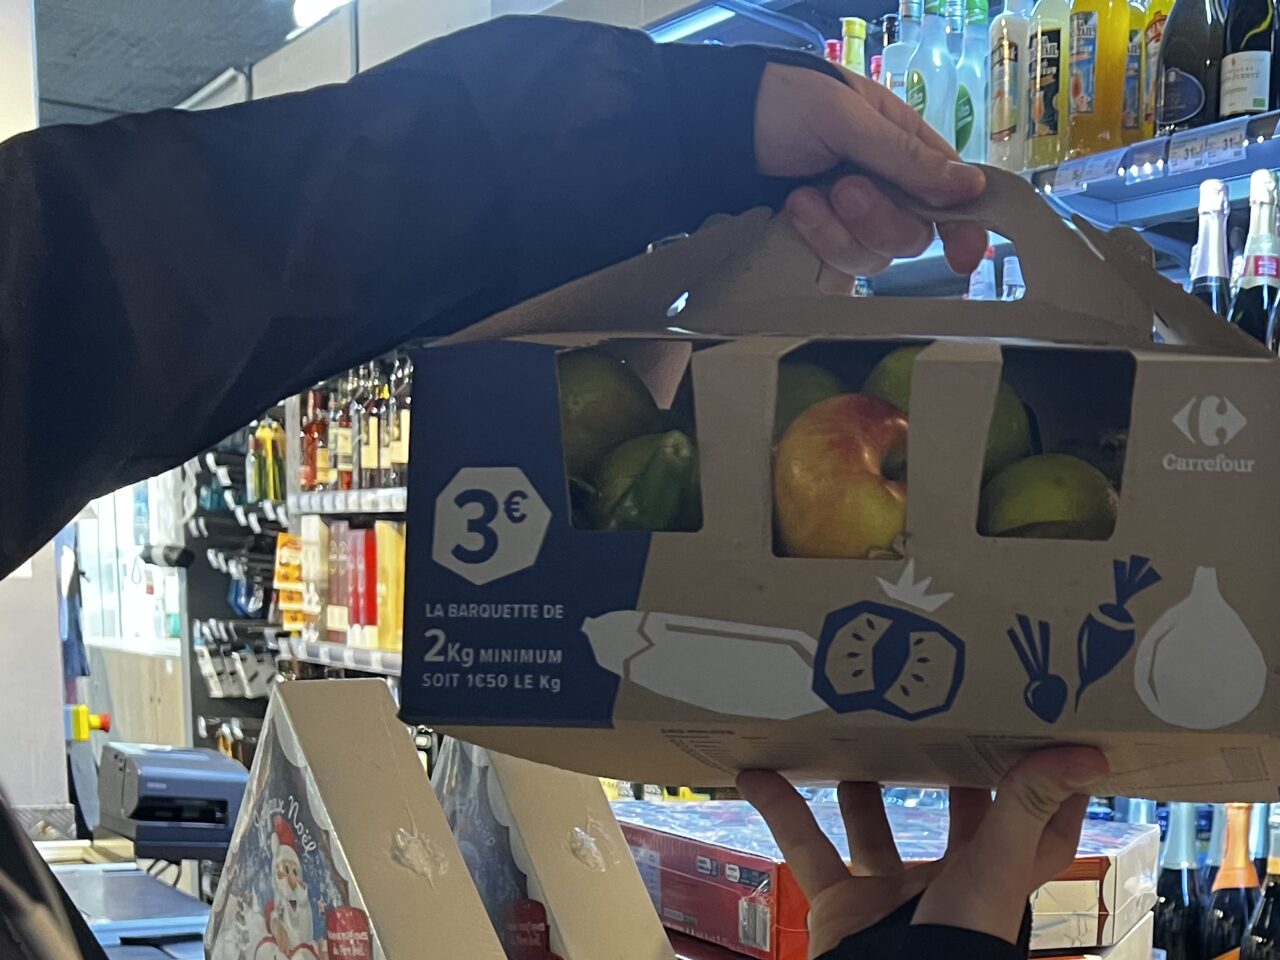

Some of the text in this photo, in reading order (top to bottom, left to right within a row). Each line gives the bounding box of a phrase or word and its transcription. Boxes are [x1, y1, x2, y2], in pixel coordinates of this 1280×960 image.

[1162, 453, 1256, 473] Carrefour
[425, 603, 564, 619] LA BARQUETTE DE
[479, 649, 563, 664] MINIMUM
[422, 673, 460, 688] SOIT
[514, 674, 534, 689] LE
[539, 675, 561, 692] Kg
